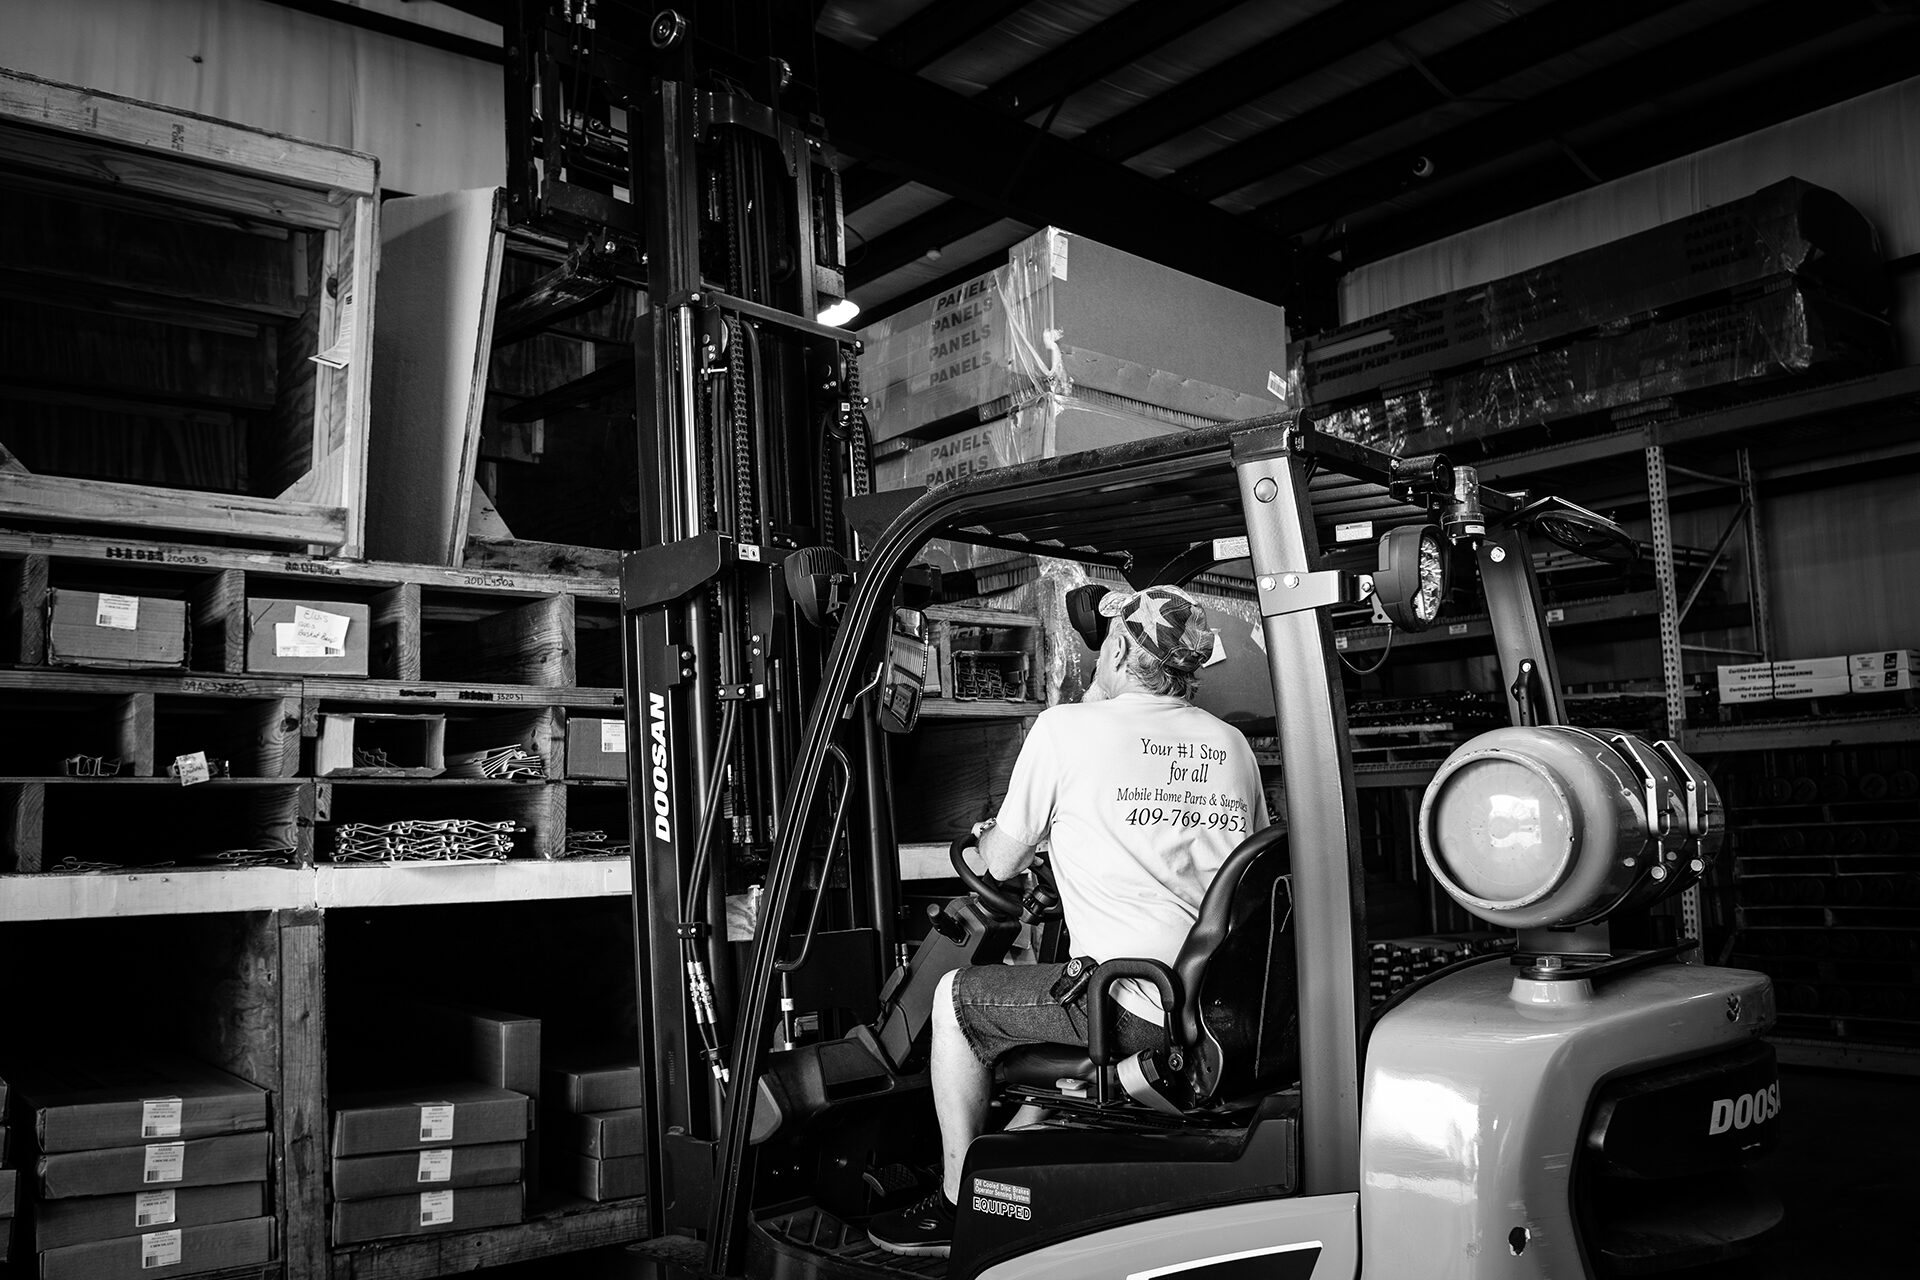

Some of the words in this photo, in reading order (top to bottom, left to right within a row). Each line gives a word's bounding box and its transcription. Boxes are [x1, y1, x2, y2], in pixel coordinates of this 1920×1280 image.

[937, 274, 997, 311] PANELS
[931, 297, 993, 335] PANELS
[929, 324, 991, 362] PANELS
[1316, 349, 1360, 369] PREMIUM
[1397, 325, 1445, 347] SKIRTING
[929, 351, 992, 387] PANELS
[1320, 363, 1363, 383] PREMIUM
[1400, 338, 1448, 360] SKIRTING
[930, 431, 991, 462] PANELS
[926, 455, 988, 486] PANELS
[464, 576, 515, 587] 20DL4502
[649, 691, 671, 843] DOOSAN
[1141, 738, 1173, 757] Your
[1177, 742, 1194, 758] #1
[1200, 743, 1227, 765] Stop
[1167, 760, 1188, 785] for
[1191, 763, 1209, 783] all
[1117, 787, 1152, 802] Mobile
[1154, 788, 1182, 803] Home
[1184, 791, 1207, 806] Parts
[1209, 793, 1217, 806] &
[1220, 794, 1248, 813] Supplies
[1126, 808, 1247, 833] 409-769-9952
[973, 1196, 1032, 1221] EQUIPPED
